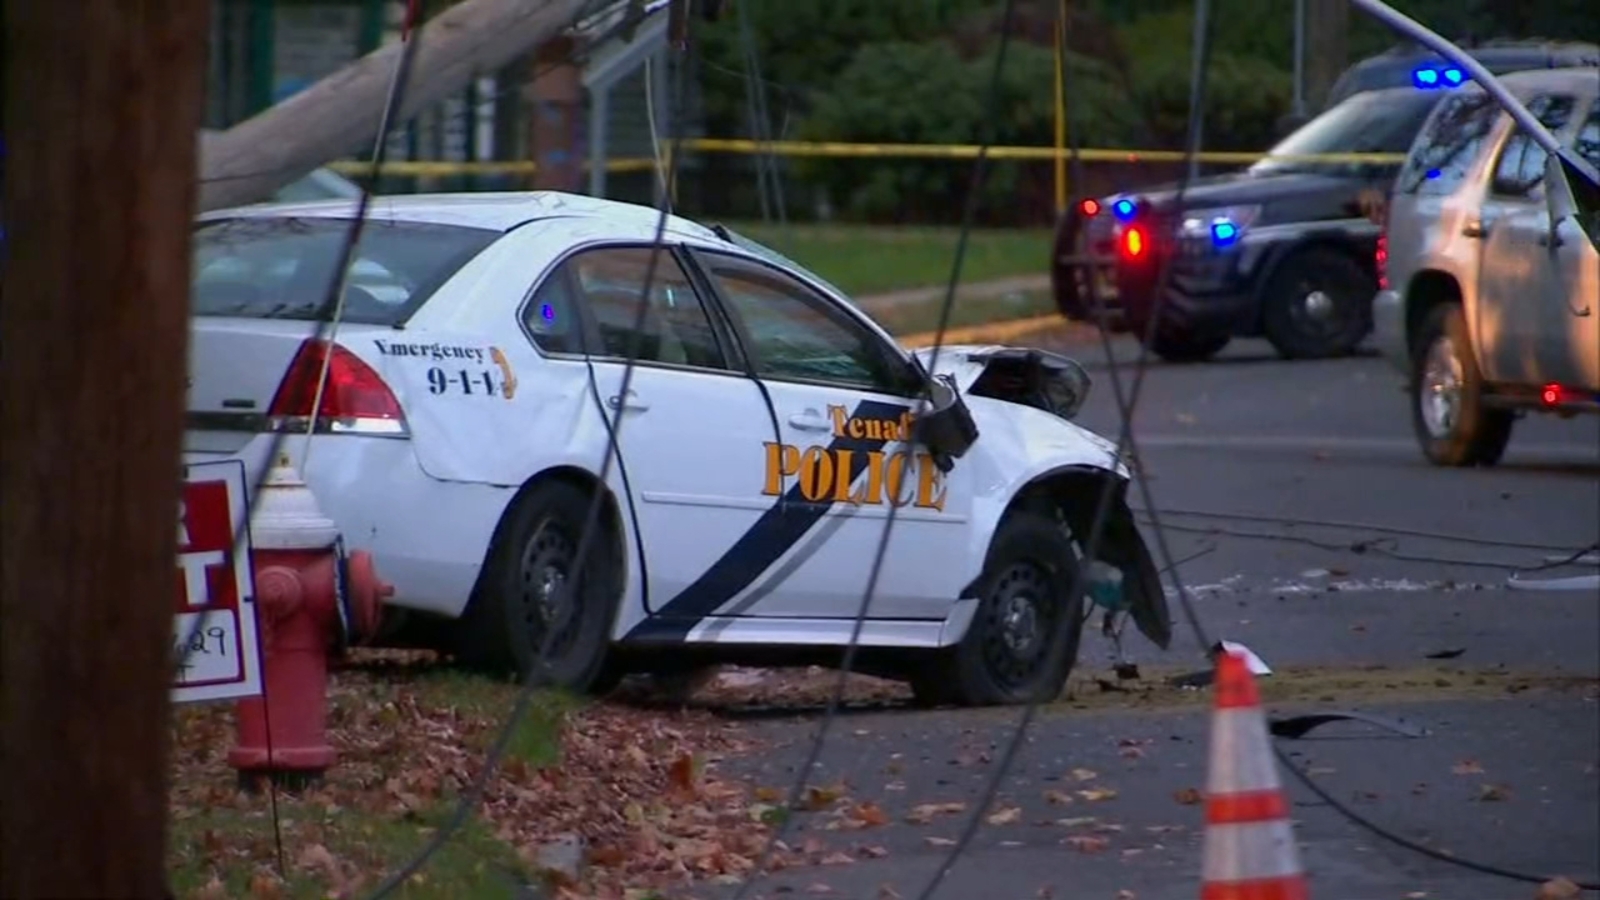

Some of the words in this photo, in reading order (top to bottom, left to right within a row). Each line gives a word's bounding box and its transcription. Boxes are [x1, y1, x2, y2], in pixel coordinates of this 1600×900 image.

[373, 338, 485, 364] Emergency
[427, 366, 497, 396] 9-1-1
[761, 440, 947, 512] POLICE
